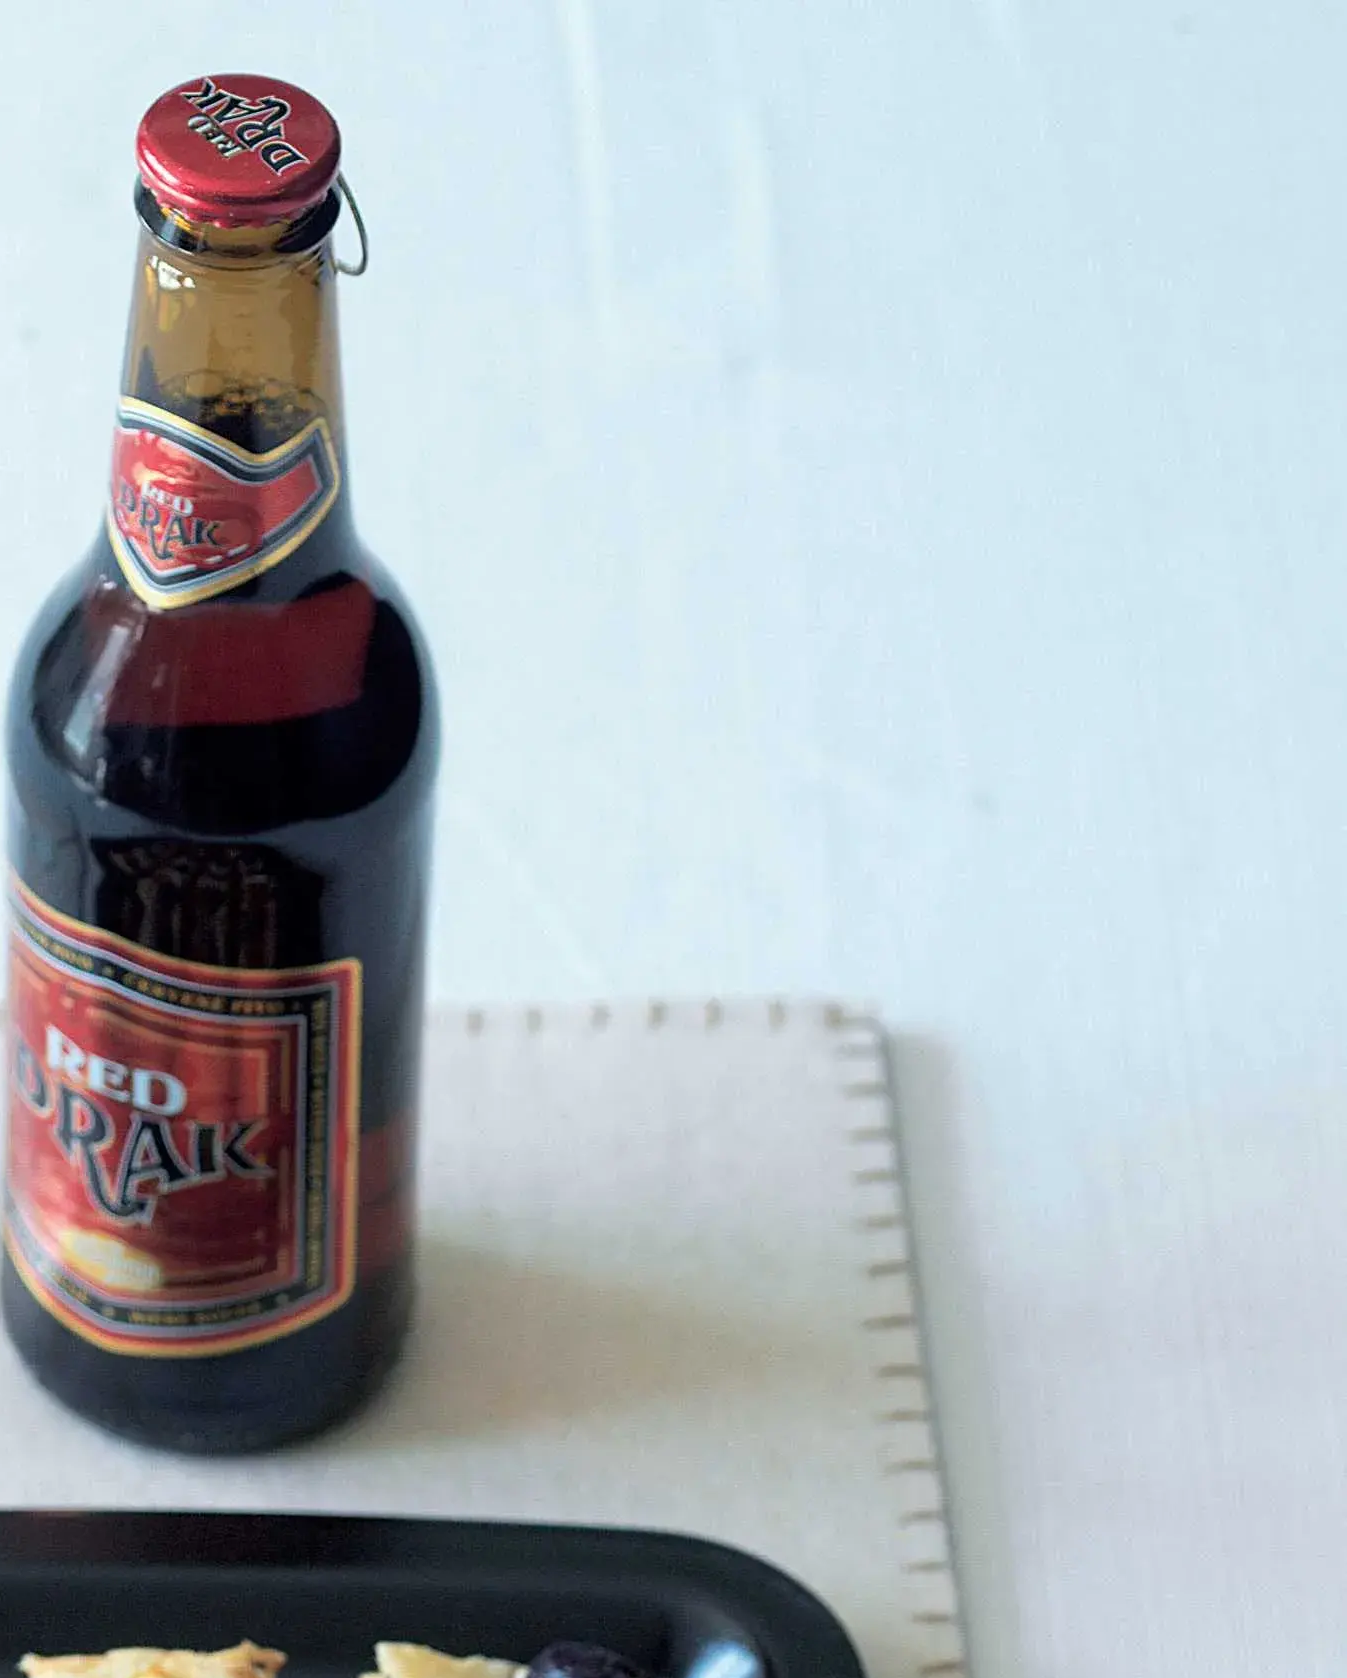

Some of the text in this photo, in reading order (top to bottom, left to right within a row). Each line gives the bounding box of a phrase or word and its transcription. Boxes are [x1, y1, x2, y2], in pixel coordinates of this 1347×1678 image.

[180, 77, 310, 176] DRAK
[187, 114, 244, 160] RED
[117, 479, 225, 561] DRAK
[140, 480, 194, 518] RED
[45, 1023, 188, 1118] RED
[13, 1035, 277, 1226] DRAK
